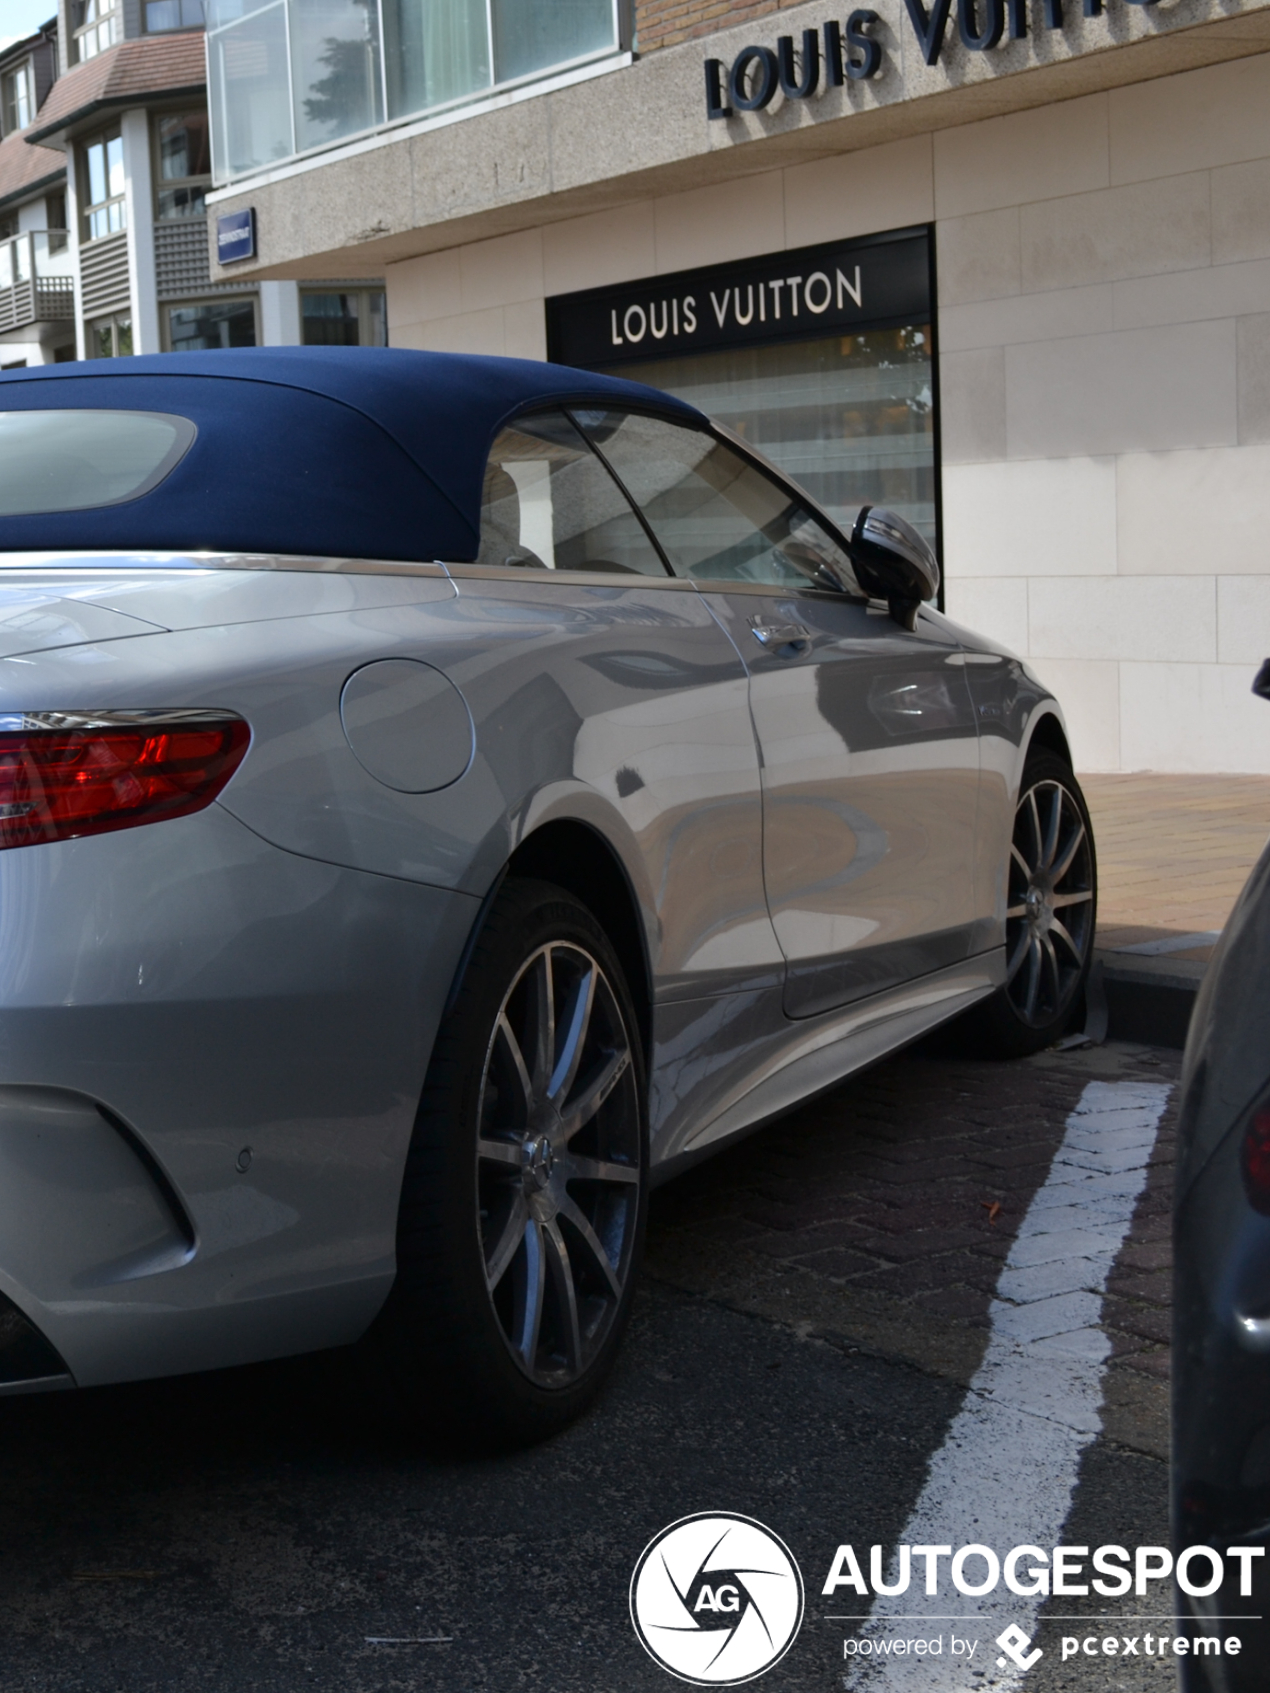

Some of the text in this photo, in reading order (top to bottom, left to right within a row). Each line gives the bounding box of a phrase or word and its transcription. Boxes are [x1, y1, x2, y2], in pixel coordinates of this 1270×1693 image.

[705, 9, 881, 119] LOUIS
[611, 265, 862, 345] LOUIS VUITTON
